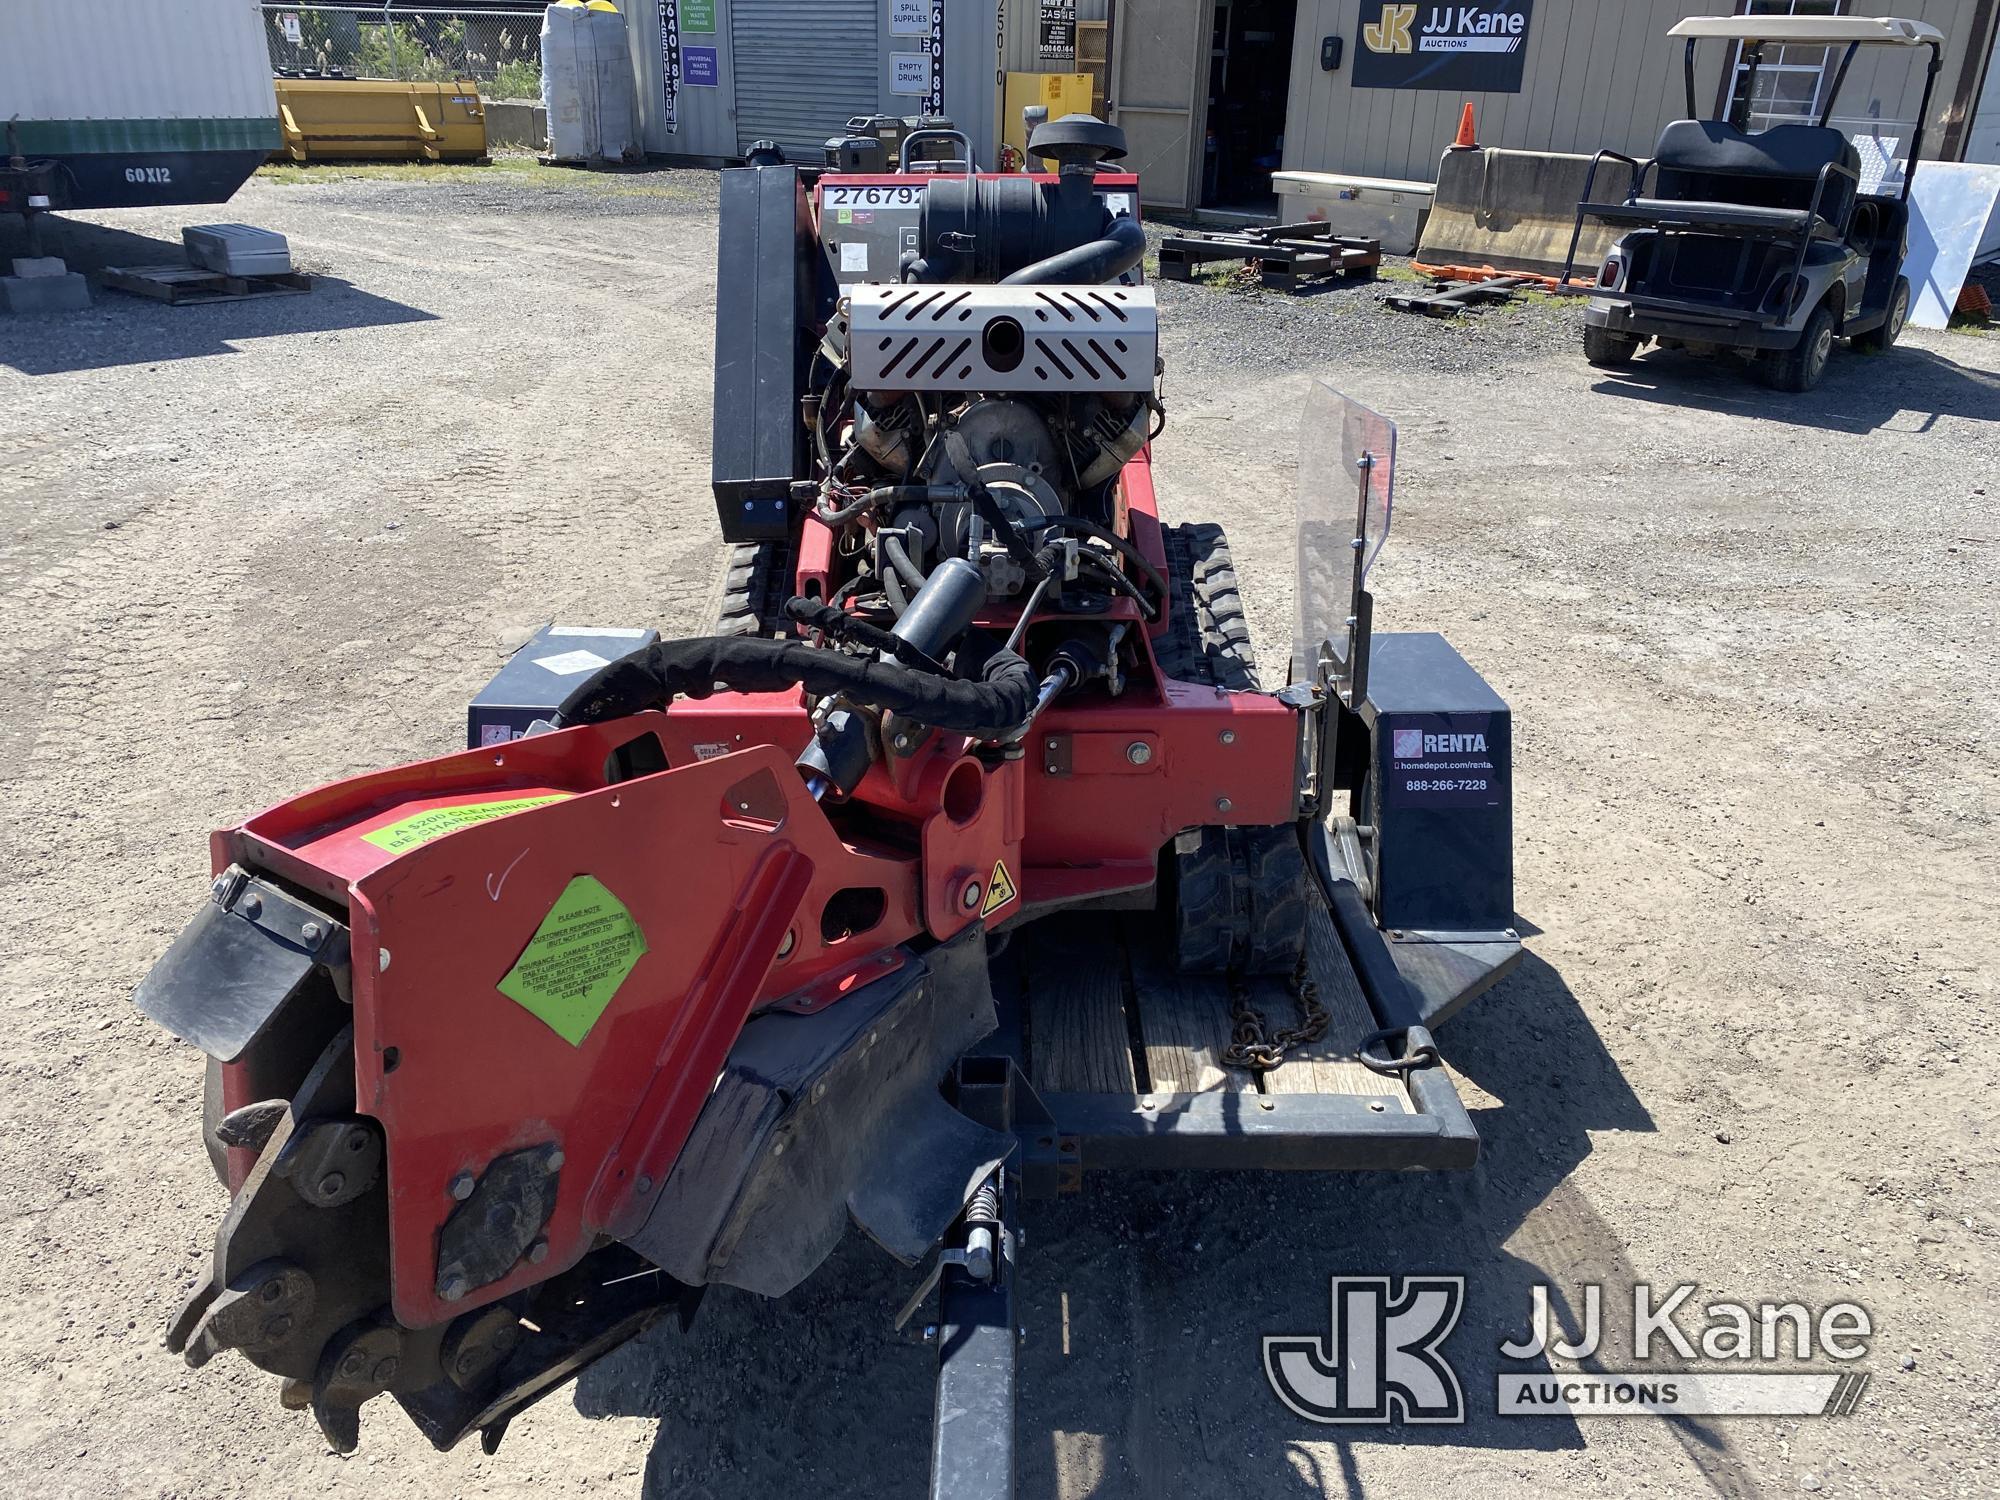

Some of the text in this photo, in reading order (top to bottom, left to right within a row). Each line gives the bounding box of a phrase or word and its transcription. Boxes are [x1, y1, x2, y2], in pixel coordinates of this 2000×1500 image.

[900, 3, 920, 12] SPILL
[893, 14, 927, 23] SUPPLIES
[1422, 7, 1525, 34] JJ Kane
[1424, 40, 1468, 48] AUCTIONS
[898, 63, 922, 71] EMPTY
[898, 73, 923, 82] DRUMS
[125, 167, 172, 183] 60X12
[1424, 734, 1490, 753] RENTA
[1401, 761, 1494, 771] homedepot.com/renta
[1406, 780, 1487, 791] 888-266-7228
[394, 828, 407, 837] A
[407, 813, 447, 830] $200
[447, 801, 530, 819] CLEANING
[389, 835, 416, 849] BE
[417, 813, 503, 838] CHARGED
[558, 910, 583, 922] PLEASE
[533, 928, 569, 944] CUSTOMER
[562, 934, 577, 945] NOT
[577, 926, 602, 941] LIMITED
[518, 955, 555, 973] INSURANCE
[562, 944, 591, 958] DAMAGE
[600, 930, 635, 947] EQUIPMENT
[522, 940, 631, 980] DAILY LUBRICATIONS CHECK OILS
[522, 947, 631, 988] FILTERS BATTERIES FLAT TIRES
[533, 958, 622, 993] TIRE DAMAGE WEAR PARTS
[546, 970, 609, 997] FUEL REPLACEMENT
